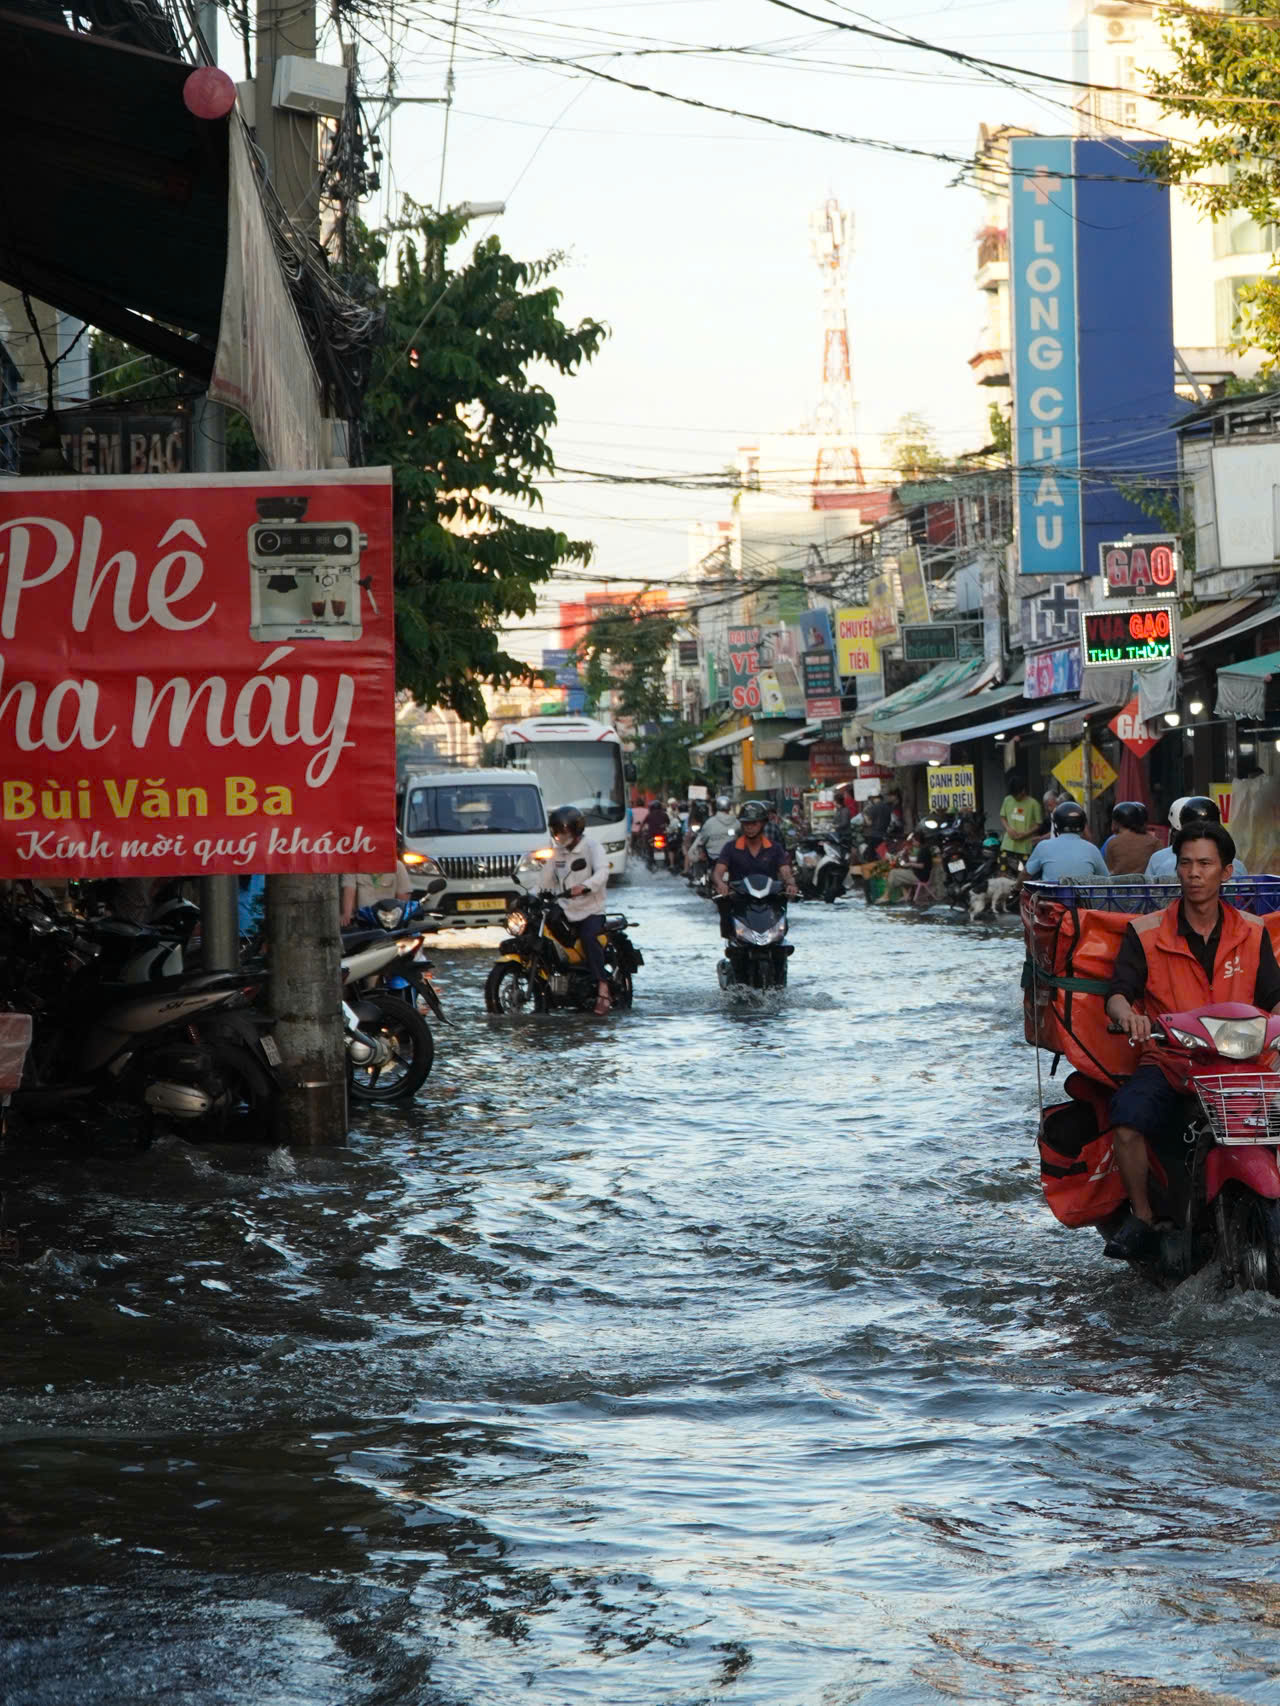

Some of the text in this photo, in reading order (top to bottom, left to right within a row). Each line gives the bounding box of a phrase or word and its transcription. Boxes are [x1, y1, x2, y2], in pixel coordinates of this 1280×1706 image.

[1026, 219, 1063, 370] LONG
[0, 516, 216, 639] Phê
[1106, 546, 1174, 594] GẠO
[1129, 611, 1170, 643] GẠO
[1089, 648, 1122, 662] THU
[733, 677, 760, 708] SỐ
[132, 647, 356, 788] máy
[3, 776, 292, 820] Bùi Văn Ba
[930, 773, 952, 789] CANH
[16, 826, 376, 866] Kính mời quý khách
